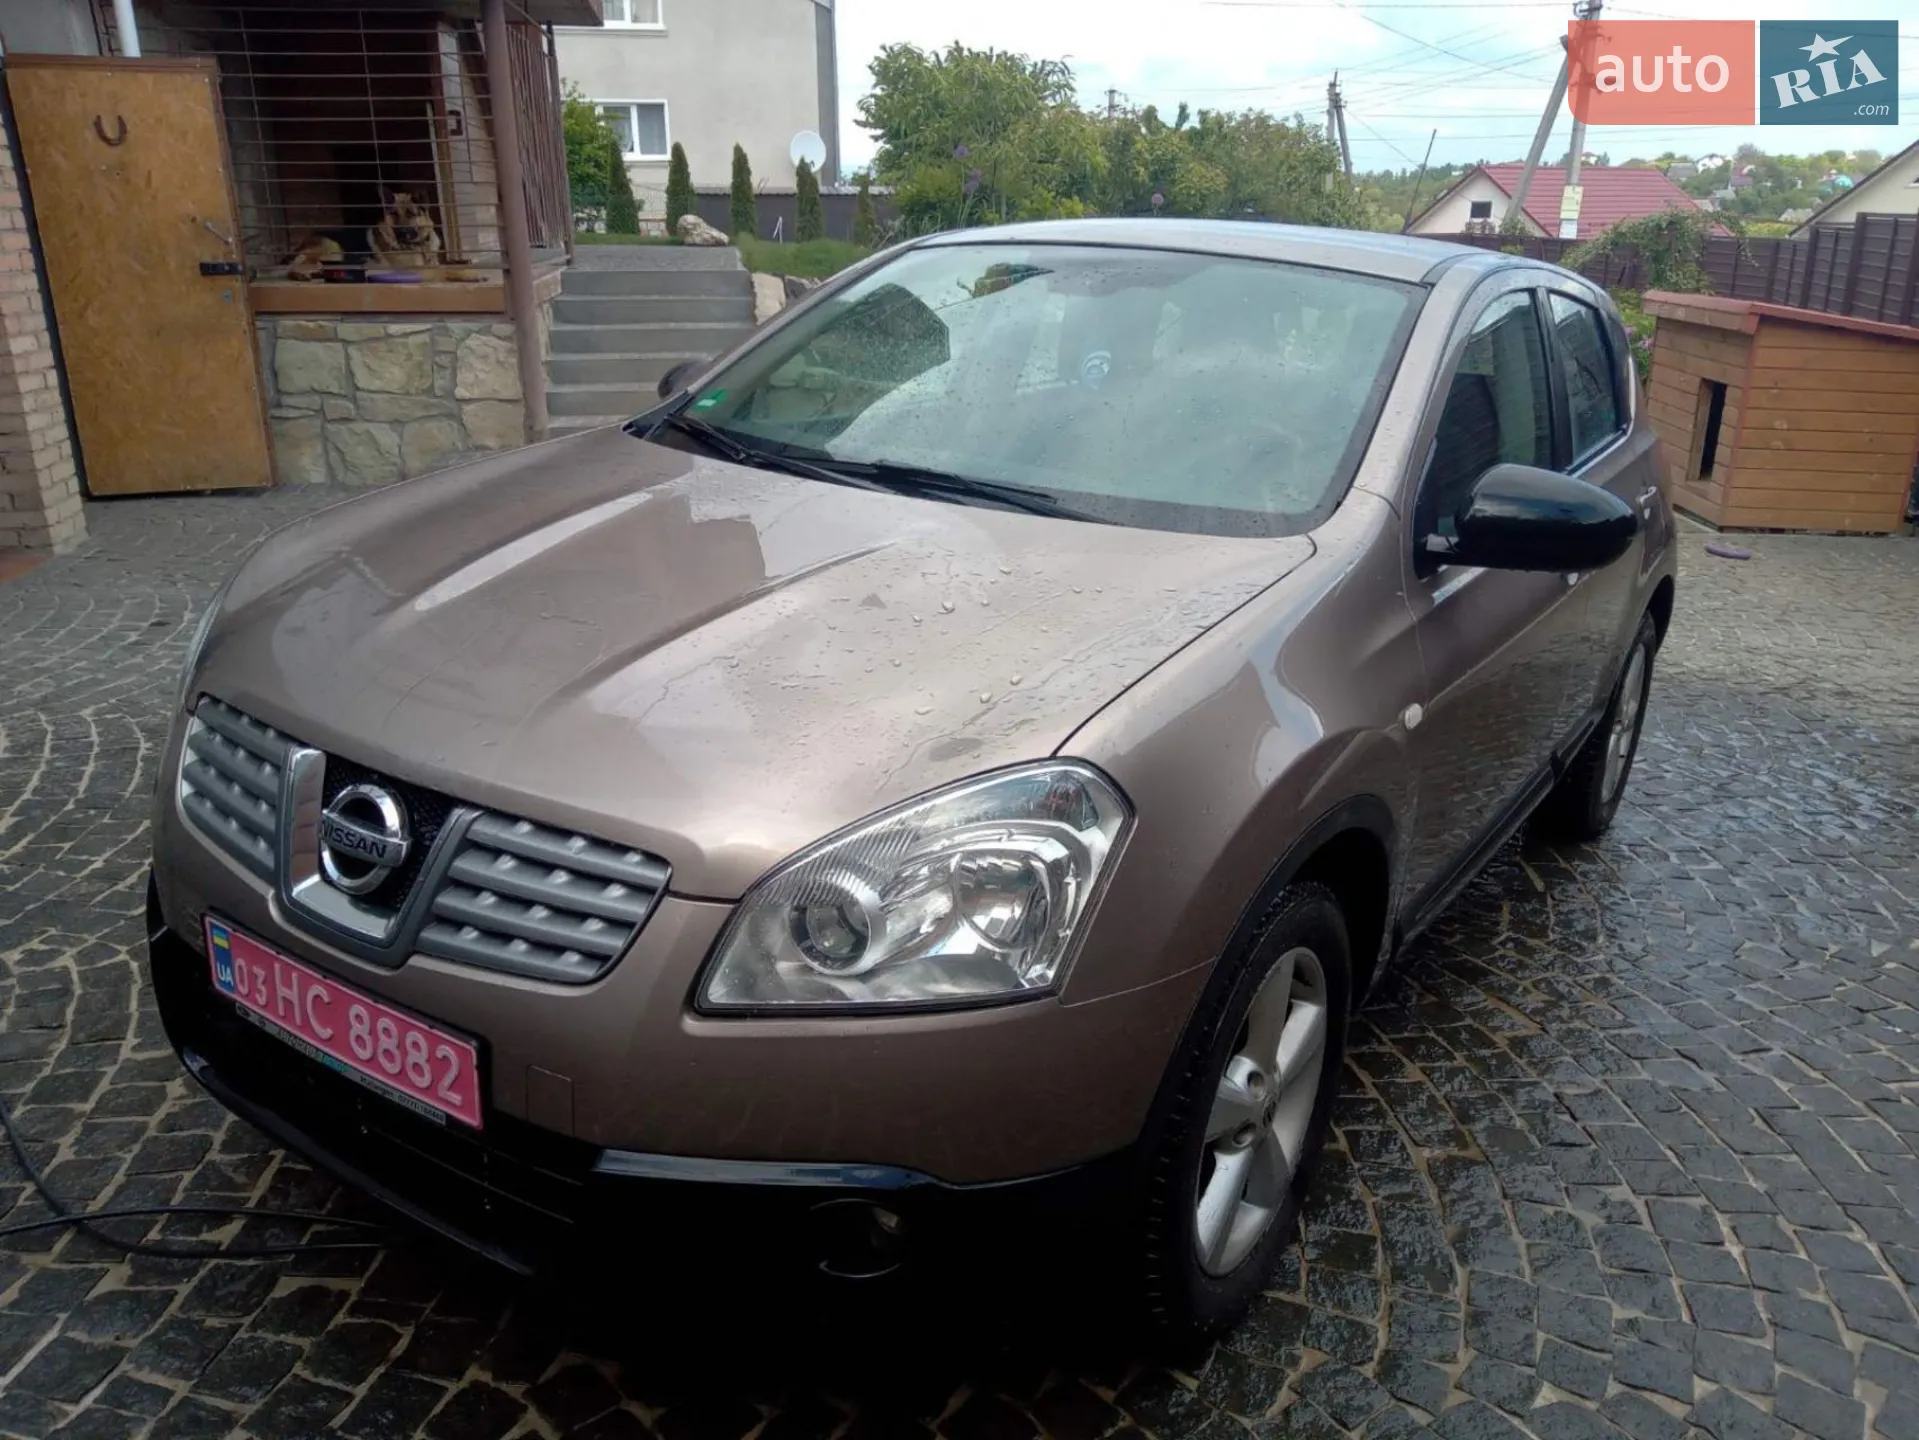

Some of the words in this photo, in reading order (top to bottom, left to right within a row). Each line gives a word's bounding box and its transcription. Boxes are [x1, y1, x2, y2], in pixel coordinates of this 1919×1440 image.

[322, 820, 388, 859] NISSAN
[216, 963, 234, 987] UA
[234, 958, 267, 1006] 03
[274, 962, 334, 1040] HC
[348, 1003, 463, 1106] 8882
